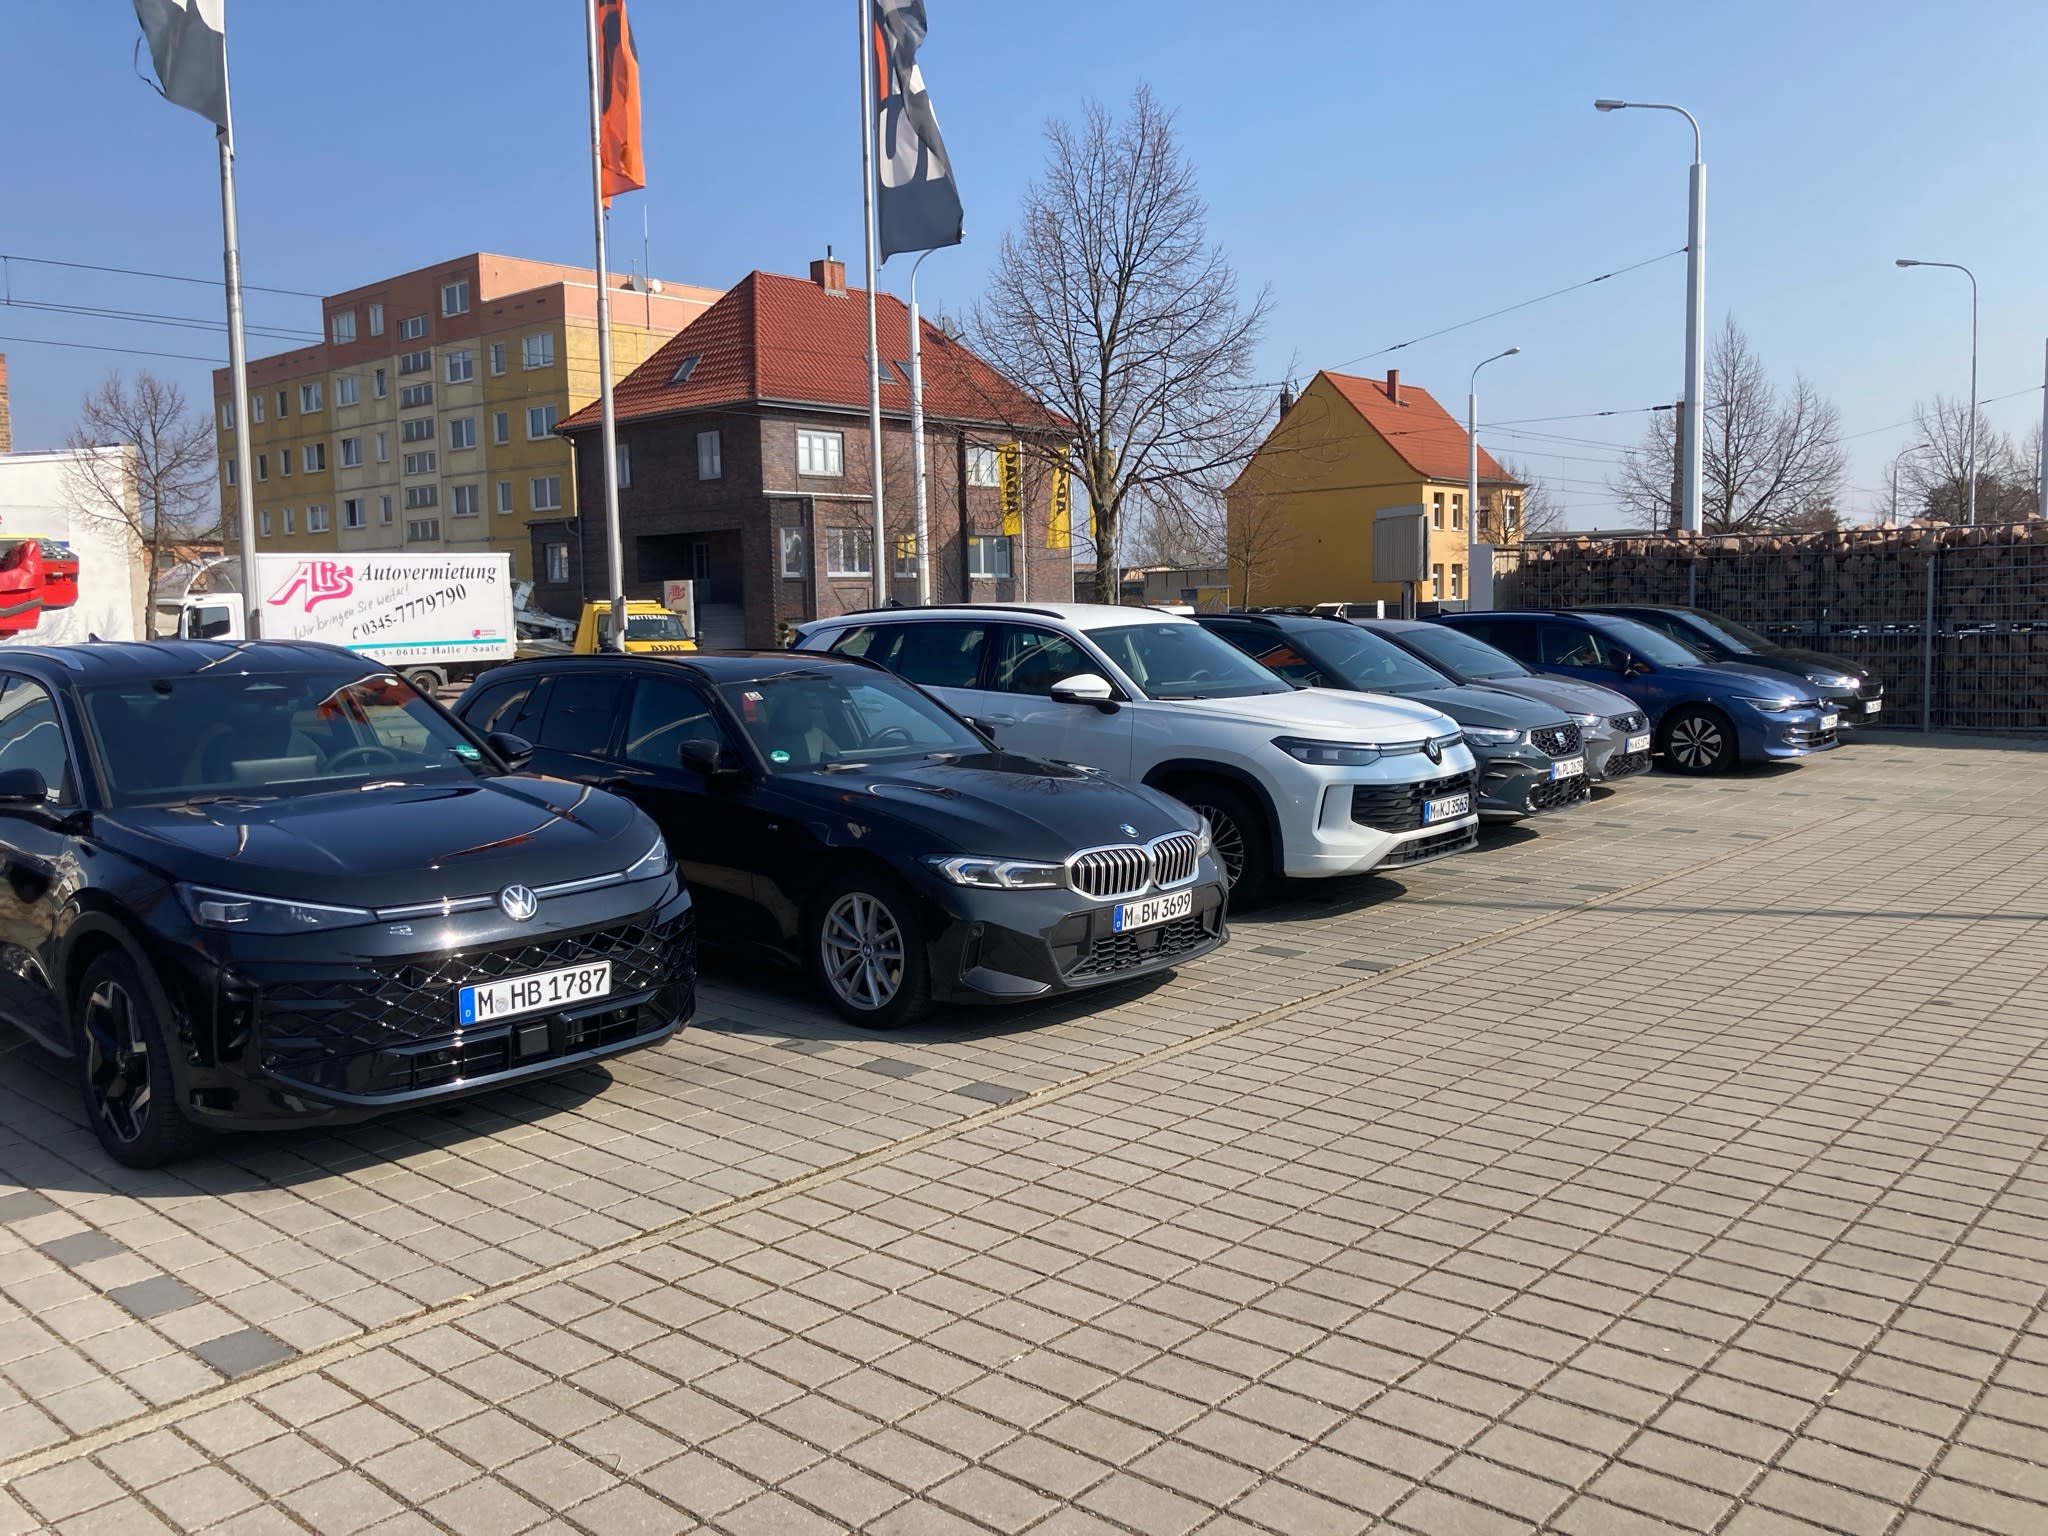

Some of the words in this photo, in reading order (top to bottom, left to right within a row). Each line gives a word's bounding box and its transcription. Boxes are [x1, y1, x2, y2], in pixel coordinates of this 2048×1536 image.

[358, 562, 497, 584] Autovermietung
[361, 583, 467, 636] 0345-7779790
[396, 647, 428, 656] 06112
[432, 646, 461, 655] Halle
[472, 644, 501, 653] Saale
[1124, 907, 1134, 928] M
[1142, 902, 1159, 924] BW
[1162, 893, 1191, 918] 3699
[478, 989, 494, 1017] M
[511, 980, 542, 1010] HB
[549, 967, 607, 1002] 1787
